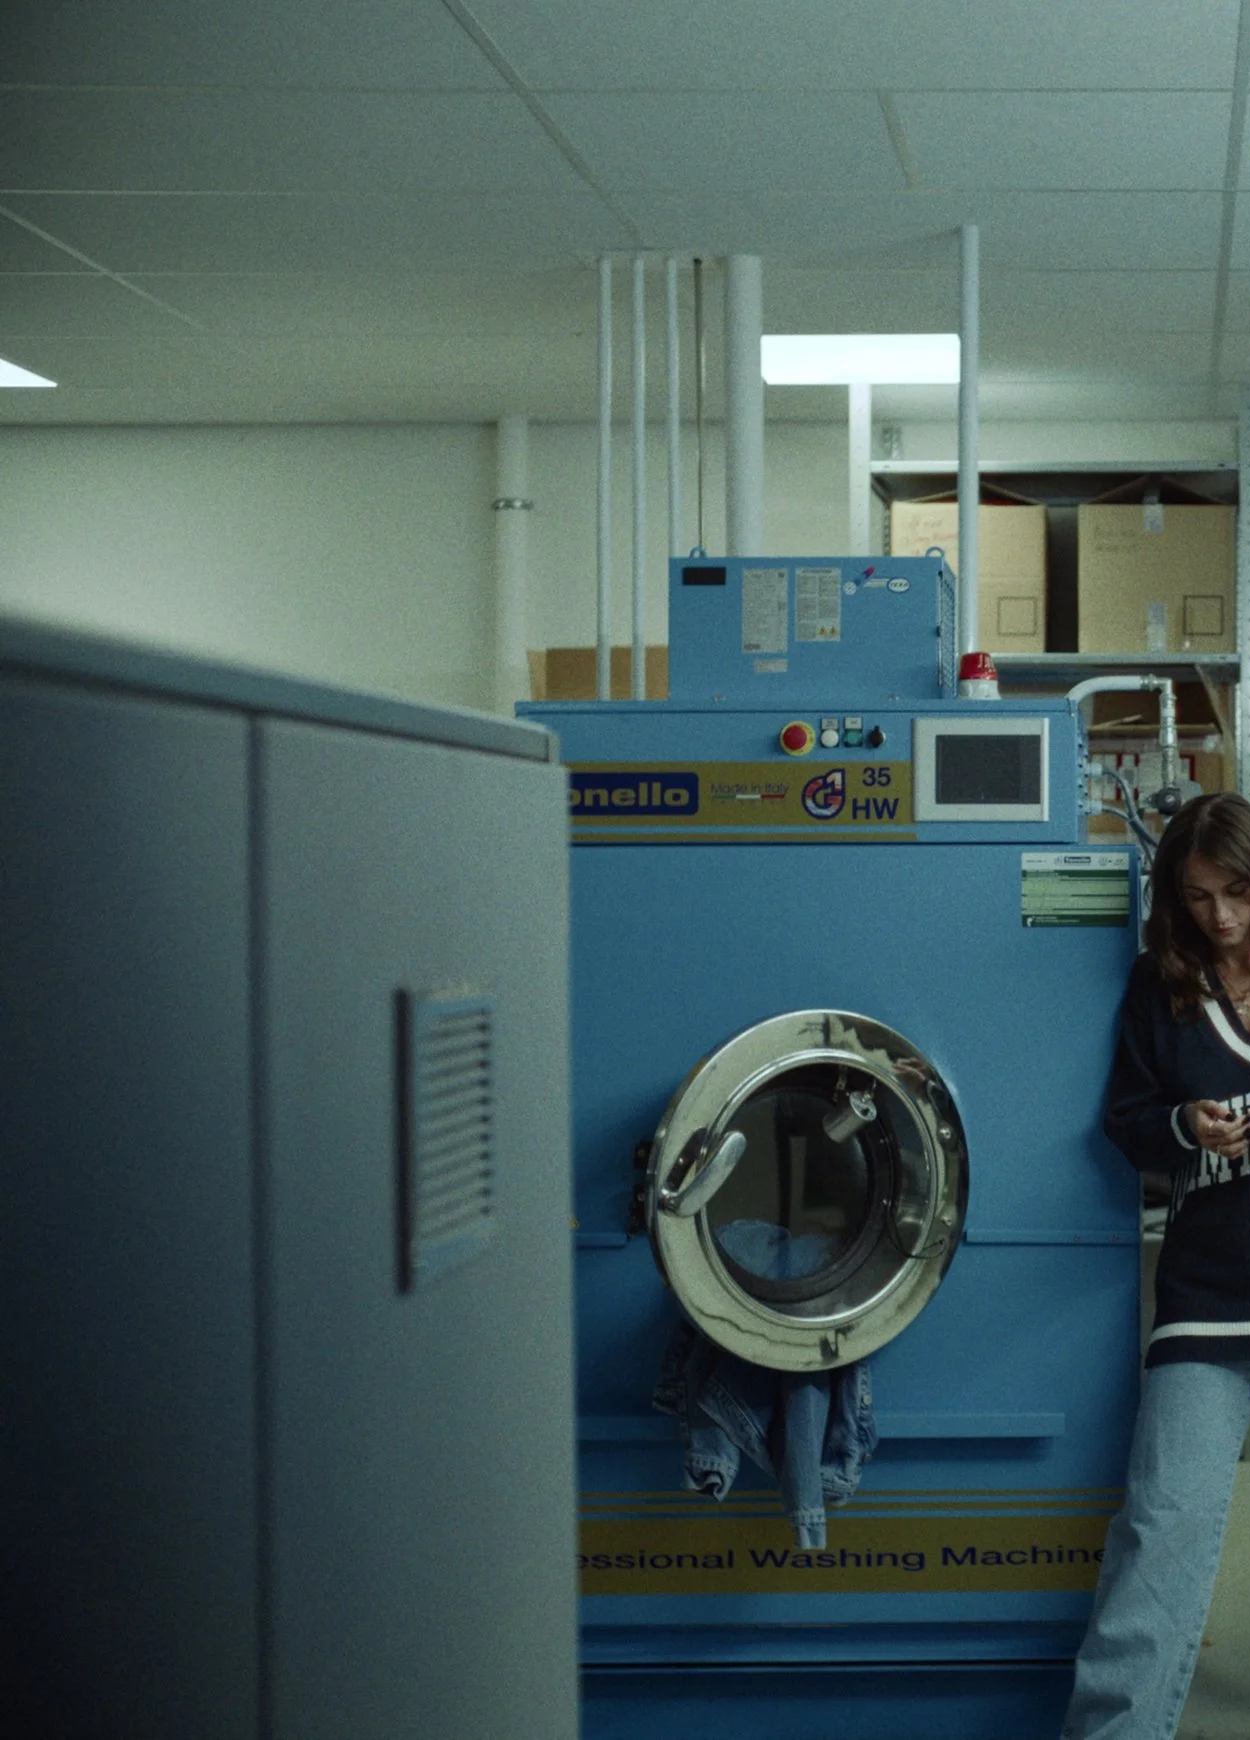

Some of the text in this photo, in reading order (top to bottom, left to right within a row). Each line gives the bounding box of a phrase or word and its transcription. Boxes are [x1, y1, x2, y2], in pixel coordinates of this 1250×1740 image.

[862, 767, 891, 787] 35
[852, 798, 899, 820] HW
[749, 1549, 925, 1571] Washing
